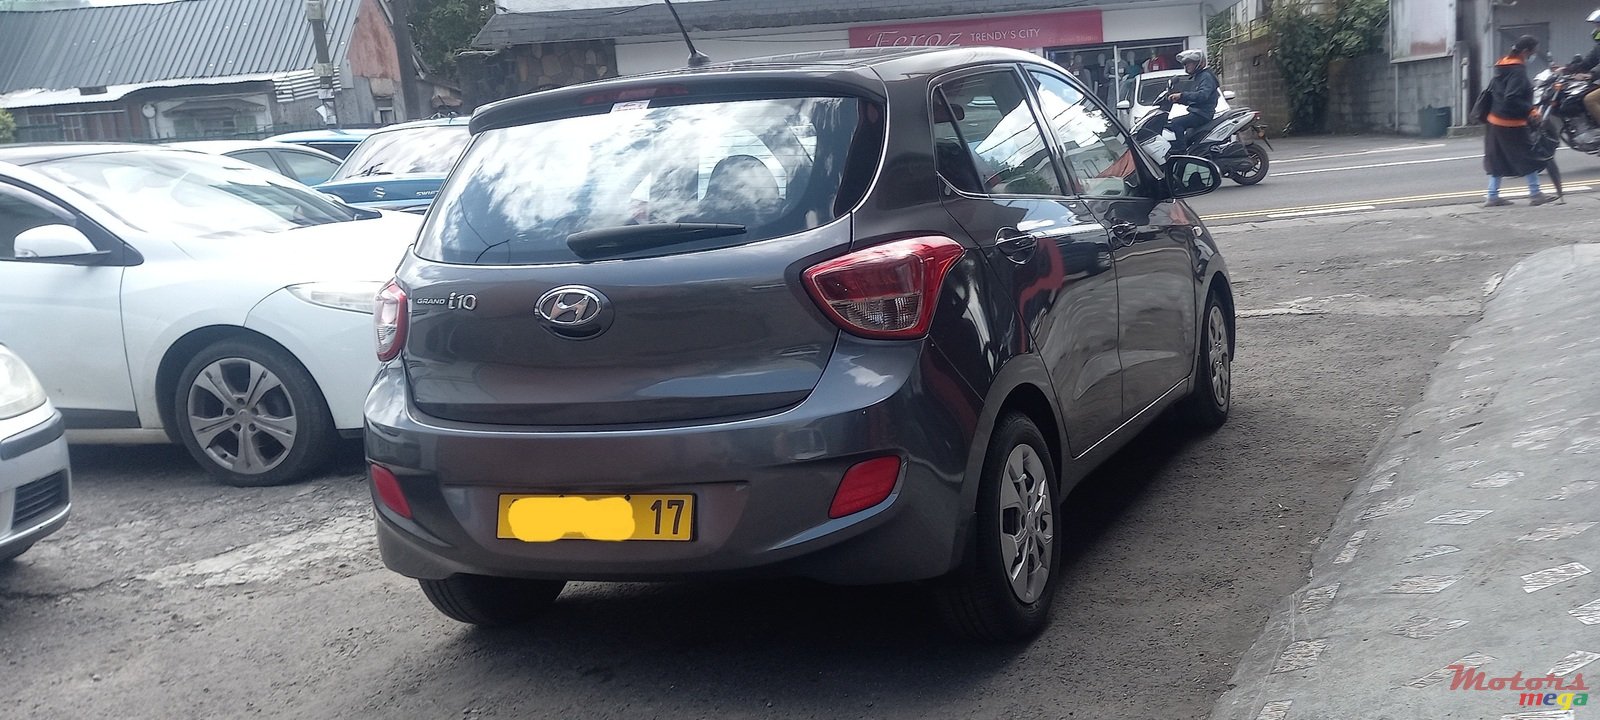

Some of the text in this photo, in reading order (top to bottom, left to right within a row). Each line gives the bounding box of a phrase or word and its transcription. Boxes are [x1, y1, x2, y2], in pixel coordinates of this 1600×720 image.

[970, 30, 1016, 42] TRENDY'S
[1018, 28, 1041, 39] CITY
[448, 292, 477, 310] i10
[650, 499, 685, 535] 17
